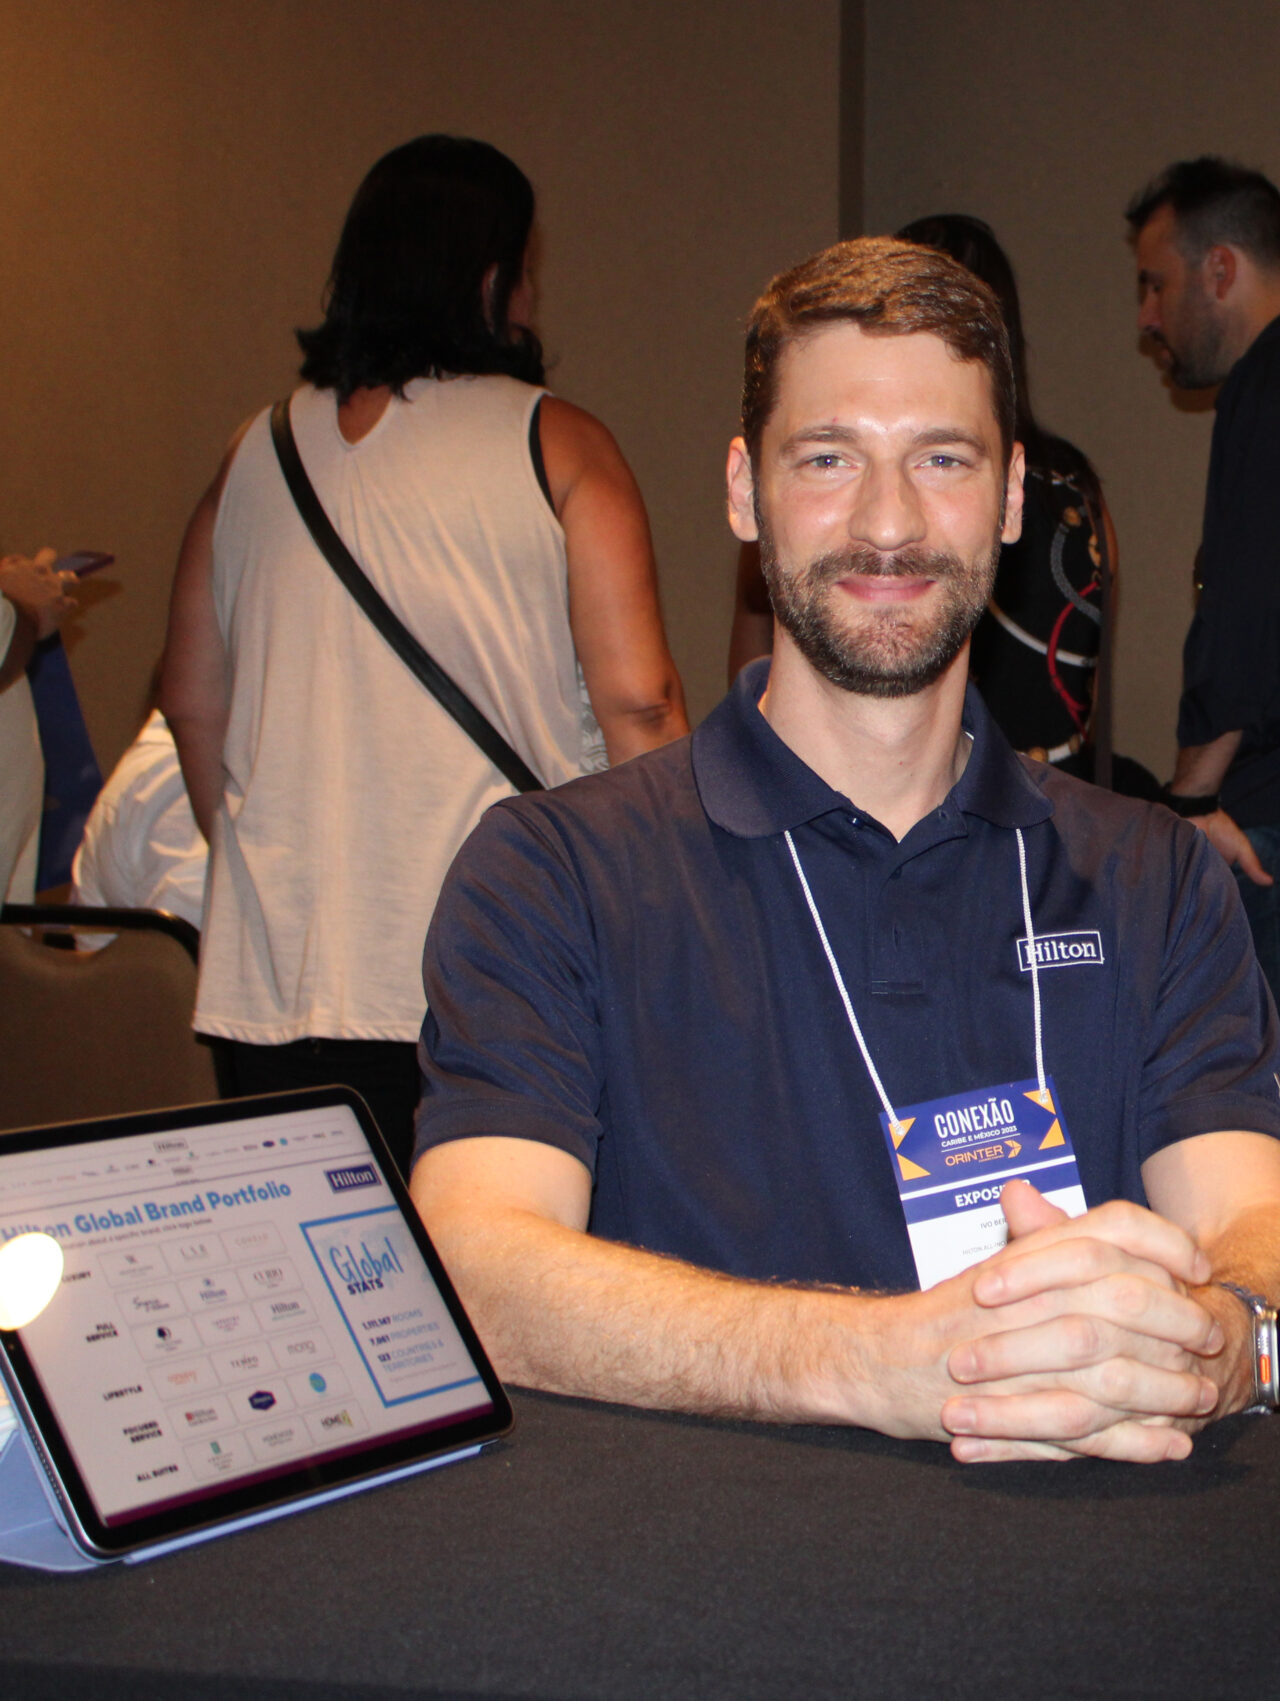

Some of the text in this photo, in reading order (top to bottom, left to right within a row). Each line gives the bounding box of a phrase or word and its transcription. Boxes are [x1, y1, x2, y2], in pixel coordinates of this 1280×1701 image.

[1025, 940, 1097, 964] Hilton
[934, 1097, 1015, 1139] CONEXÃO
[941, 1125, 1018, 1148] CARIBE E MÉXICO 2023
[945, 1144, 1004, 1166] ORINTER
[329, 1167, 375, 1190] Hilton
[74, 1205, 143, 1233] Global
[144, 1193, 206, 1222] Brand
[206, 1181, 292, 1210] Portfolio
[329, 1237, 404, 1282] Global
[347, 1278, 384, 1295] STATS
